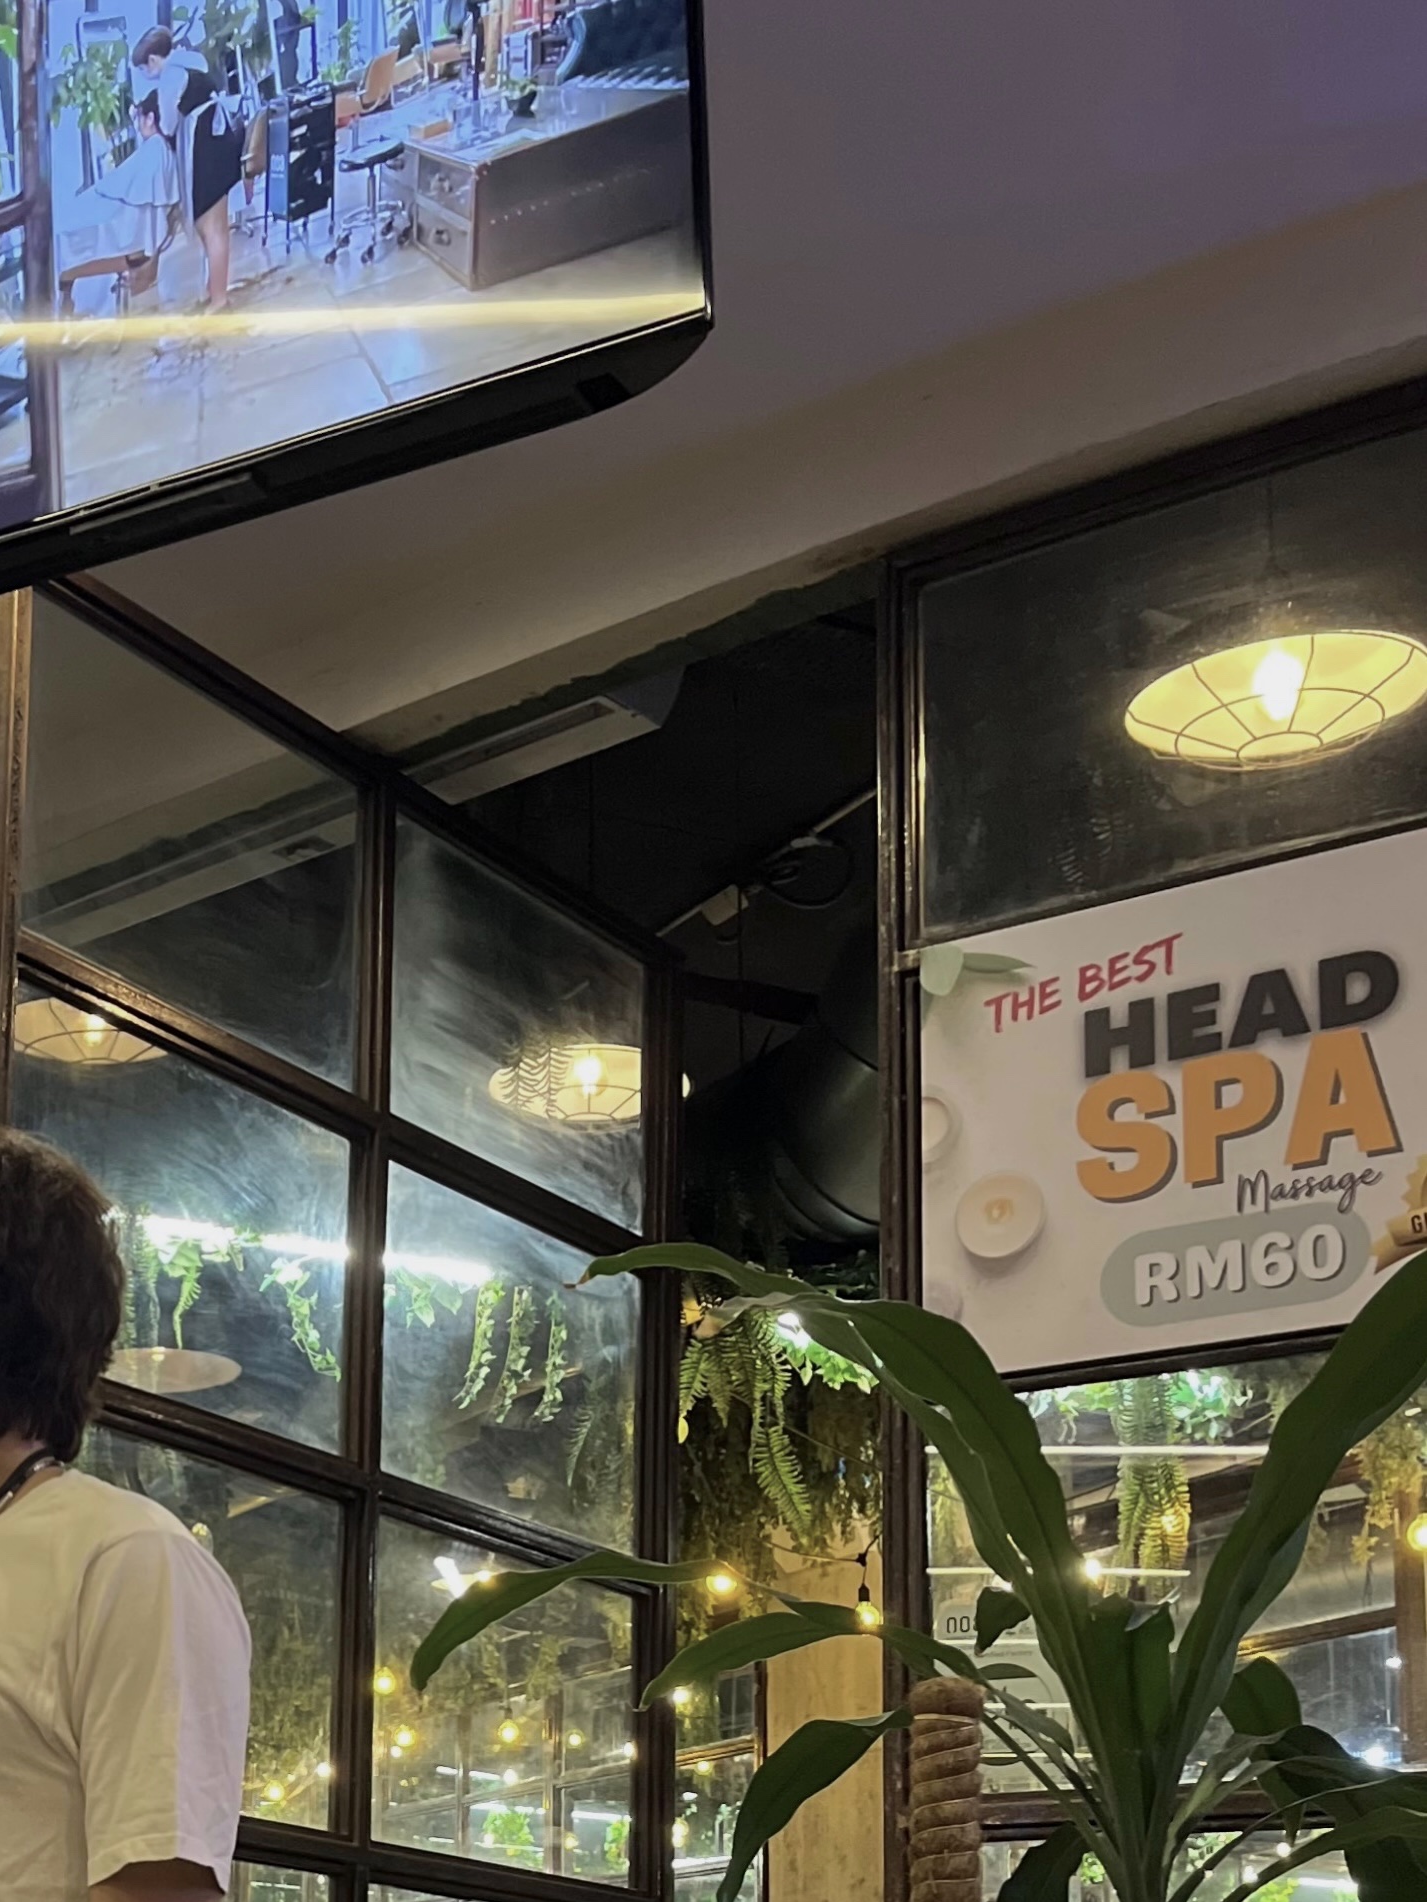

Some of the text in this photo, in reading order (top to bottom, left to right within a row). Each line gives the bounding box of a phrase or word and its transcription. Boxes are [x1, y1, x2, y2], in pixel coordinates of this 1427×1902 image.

[984, 932, 1184, 1033] THE BEST
[1084, 950, 1399, 1078] HEAD
[1076, 1027, 1403, 1204] SPA
[1236, 1168, 1383, 1214] Massage
[1134, 1223, 1347, 1307] RM60
